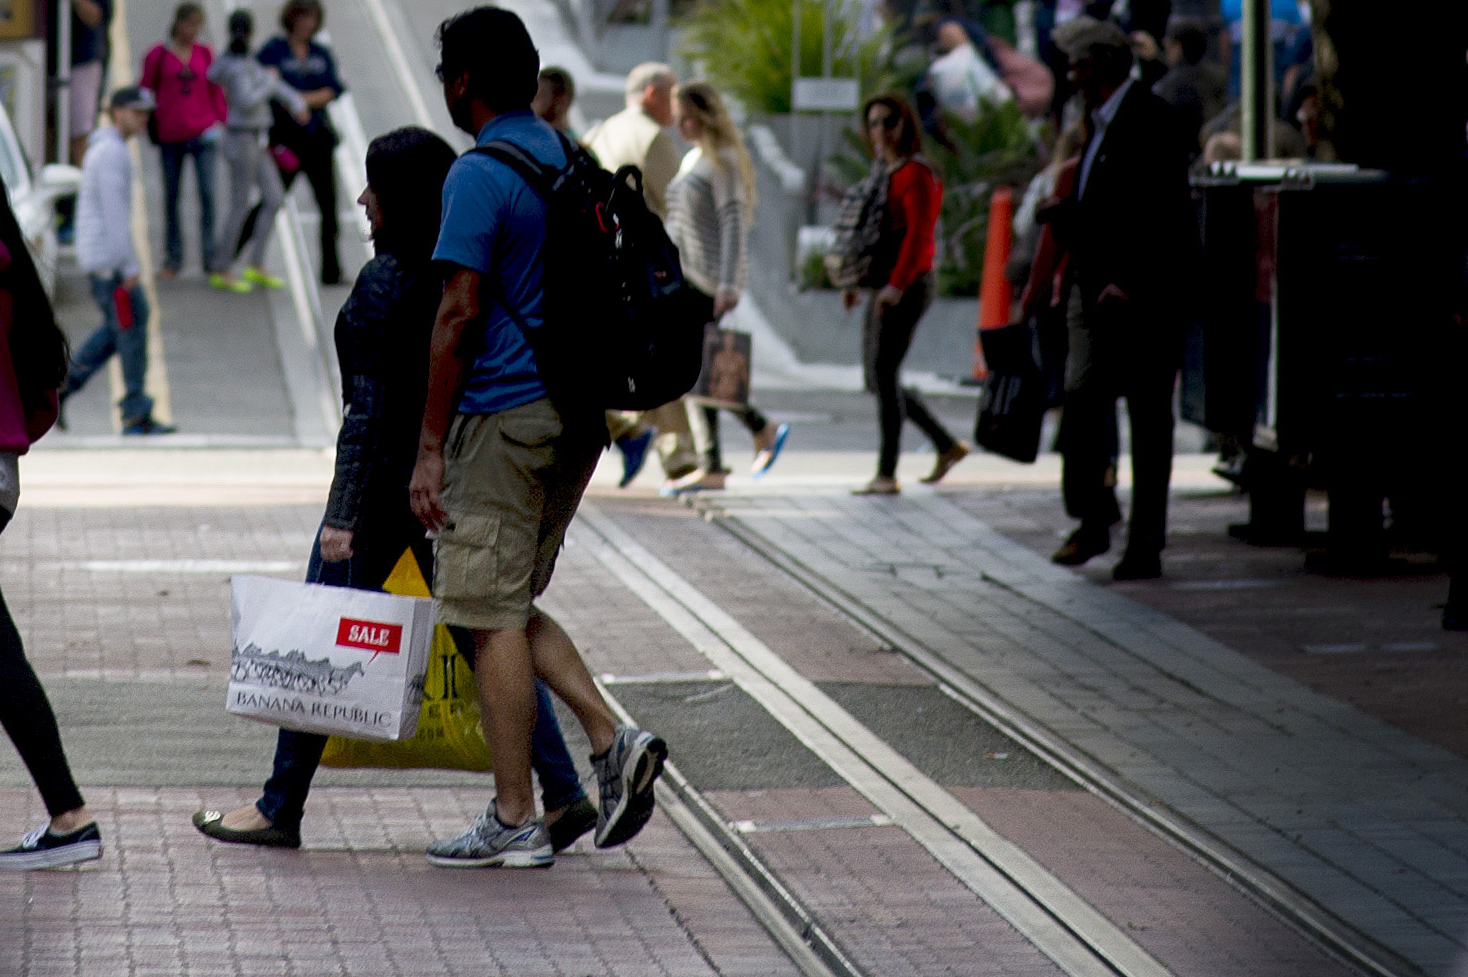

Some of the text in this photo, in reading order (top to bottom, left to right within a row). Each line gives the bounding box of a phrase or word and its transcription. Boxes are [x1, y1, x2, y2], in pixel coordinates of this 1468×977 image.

[348, 624, 391, 647] SALE
[236, 690, 392, 728] BANANA REPUBLIC
